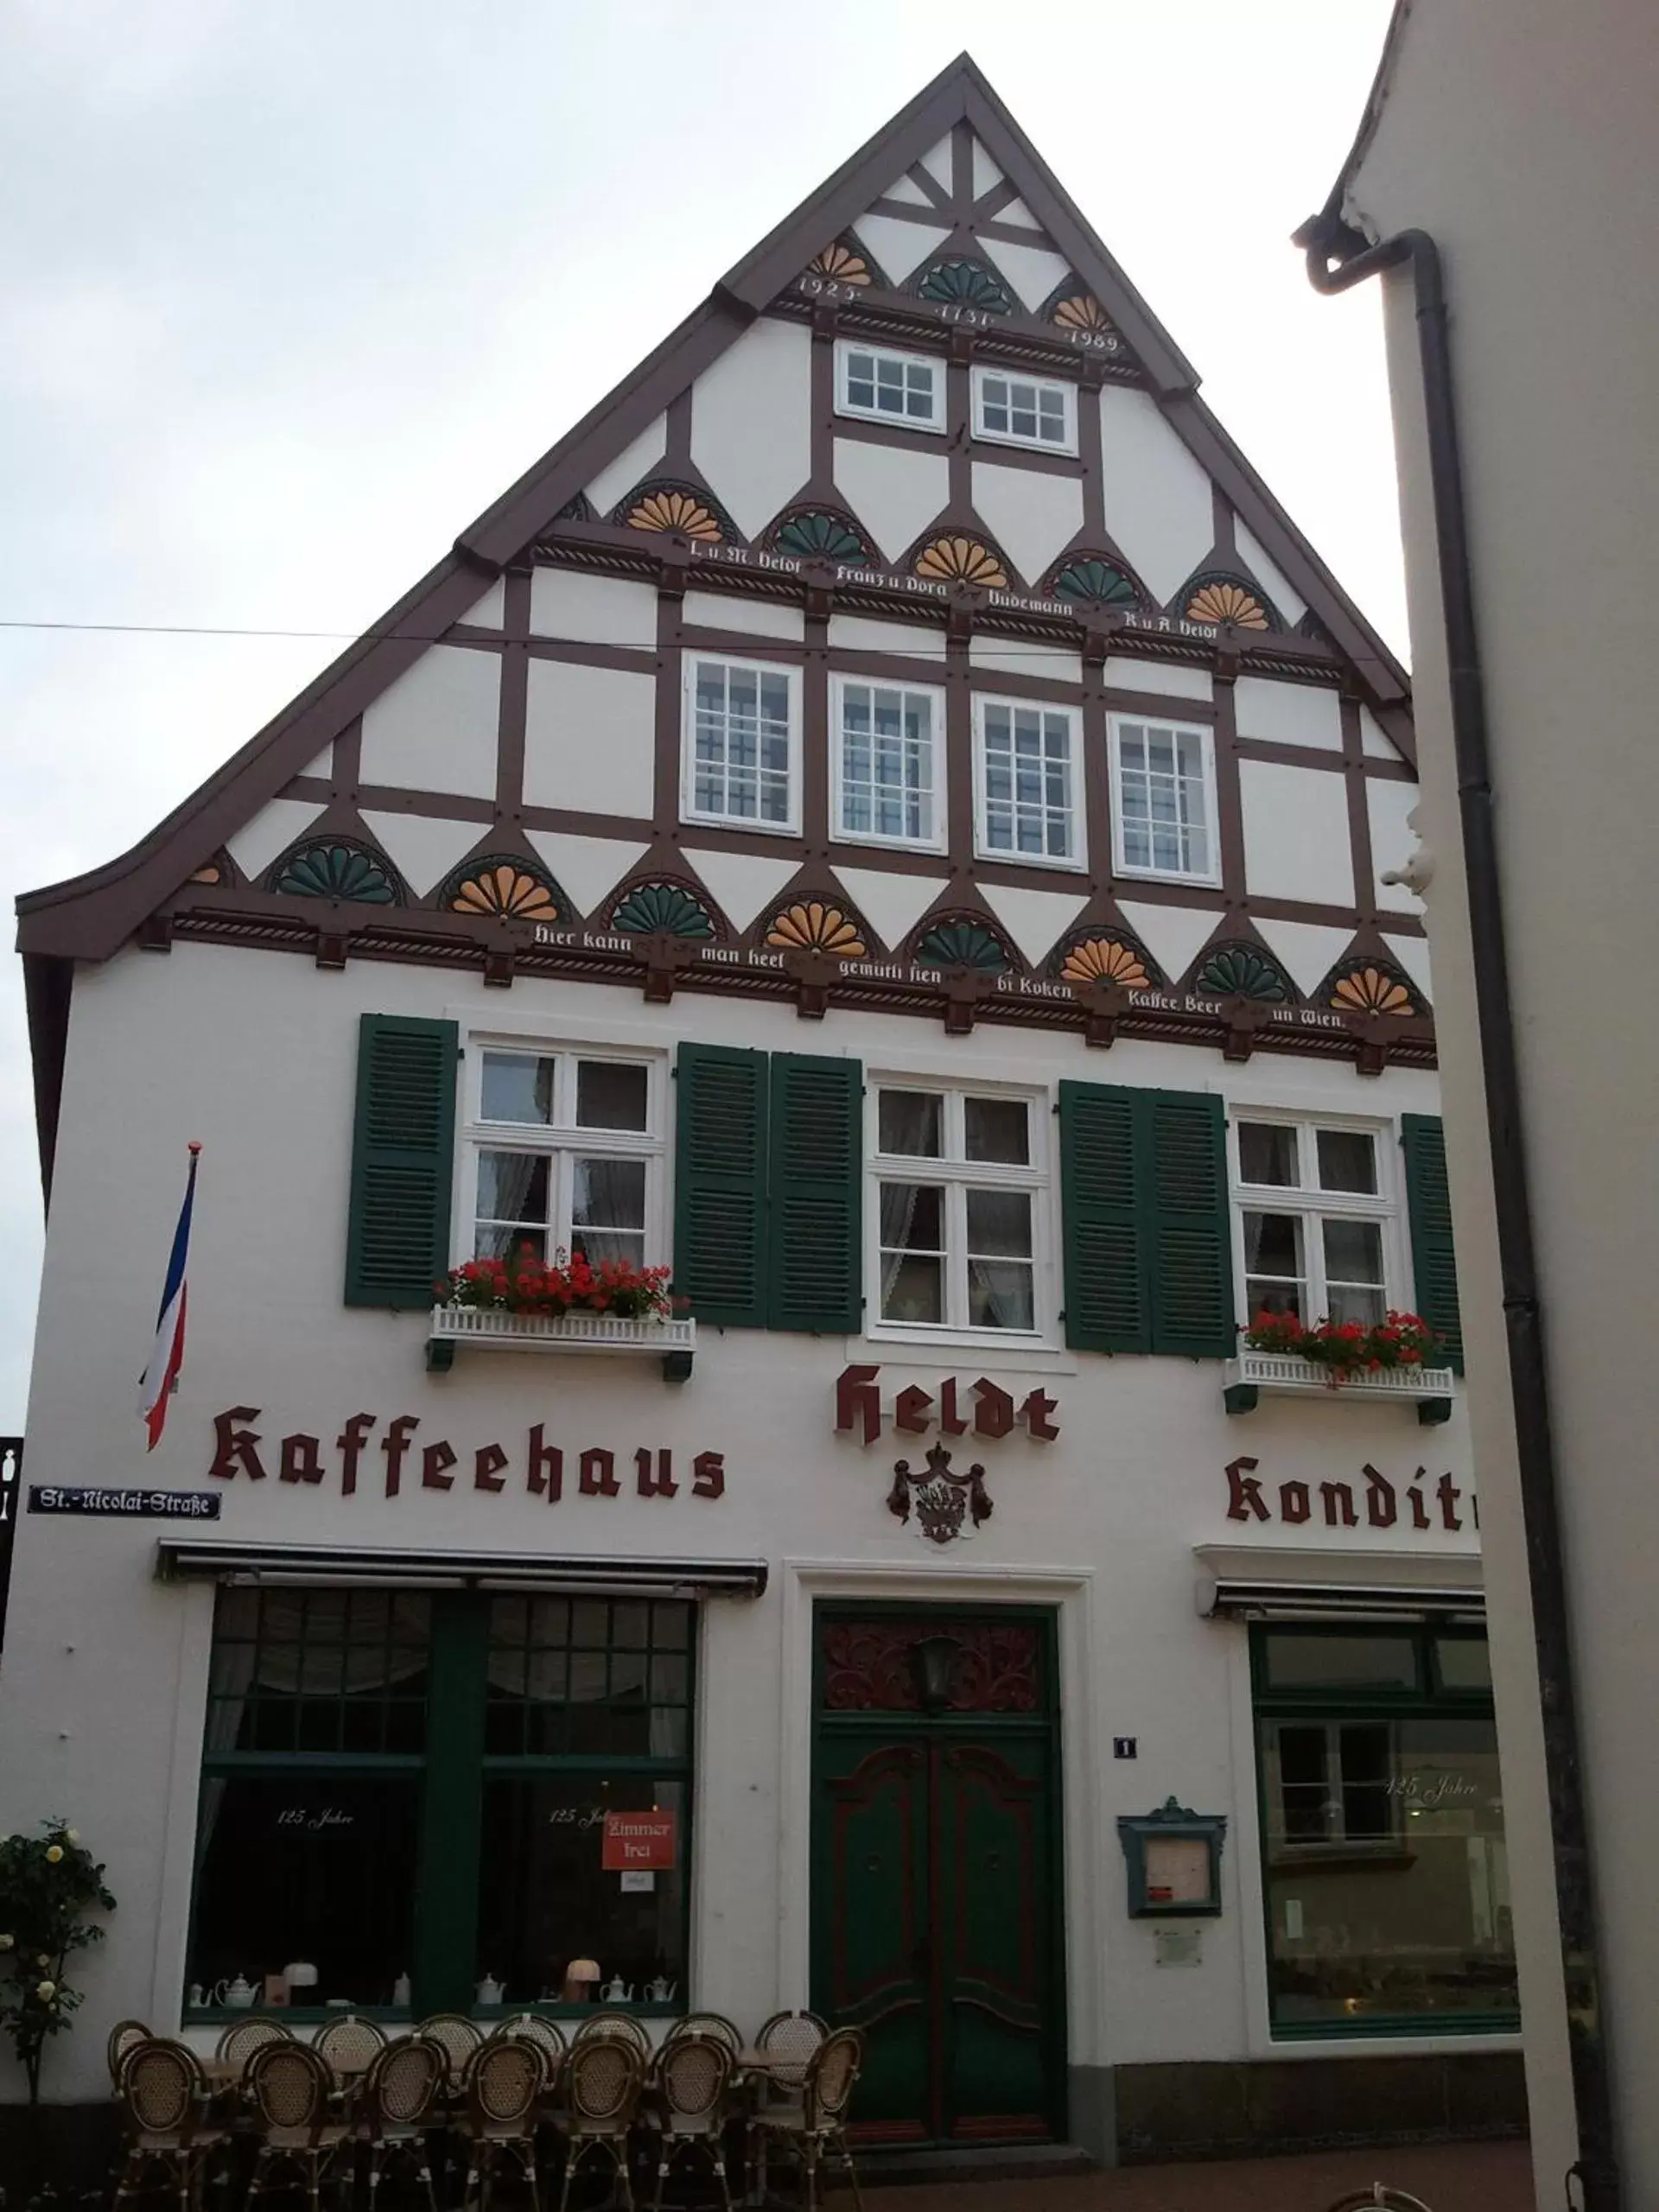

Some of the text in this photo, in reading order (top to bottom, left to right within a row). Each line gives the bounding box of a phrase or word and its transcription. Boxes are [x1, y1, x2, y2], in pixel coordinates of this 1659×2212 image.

[1071, 330, 1118, 351] 1989
[836, 565, 884, 588] Franz
[906, 575, 948, 596] Dora
[533, 923, 575, 944] Hier
[582, 931, 632, 950] kann
[701, 947, 740, 963] man
[1185, 995, 1222, 1014] Beer
[1273, 1008, 1294, 1021] un
[836, 1364, 1061, 1445] Heldt
[210, 1405, 727, 1504] Kaffeehaus
[1224, 1456, 1479, 1531] Kondit
[607, 1817, 672, 1837] Zimmer
[624, 1842, 651, 1858] frei
